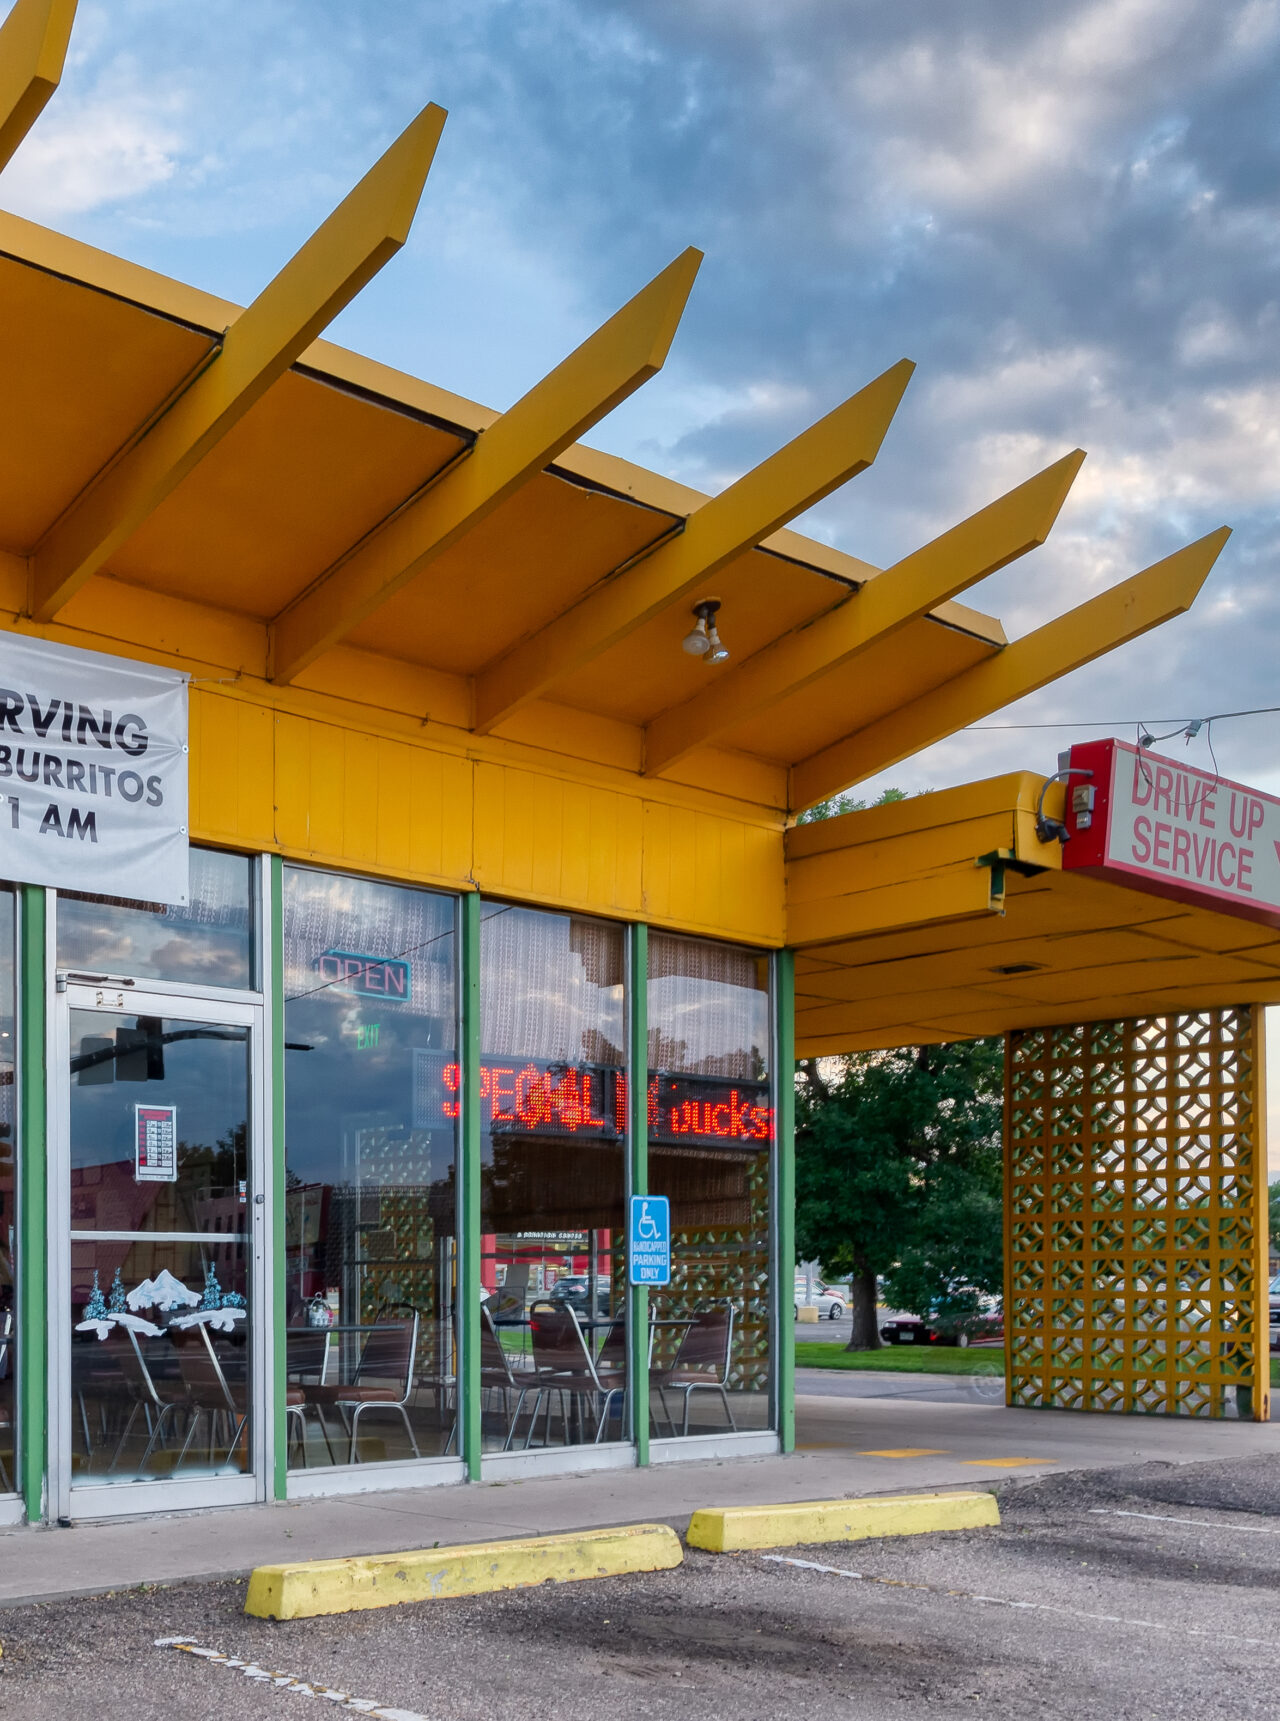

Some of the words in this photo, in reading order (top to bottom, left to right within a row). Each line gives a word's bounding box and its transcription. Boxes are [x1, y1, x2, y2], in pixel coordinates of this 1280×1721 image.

[1132, 758, 1218, 829] DRIVE
[1229, 792, 1265, 841] UP
[39, 803, 98, 843] AM
[1131, 815, 1254, 892] SERVICE
[319, 956, 404, 993] OPEN
[357, 1023, 380, 1050] EXIT
[633, 1241, 667, 1253] HANDICAPPED
[633, 1254, 667, 1266] PARKING
[640, 1267, 659, 1279] ONLY
